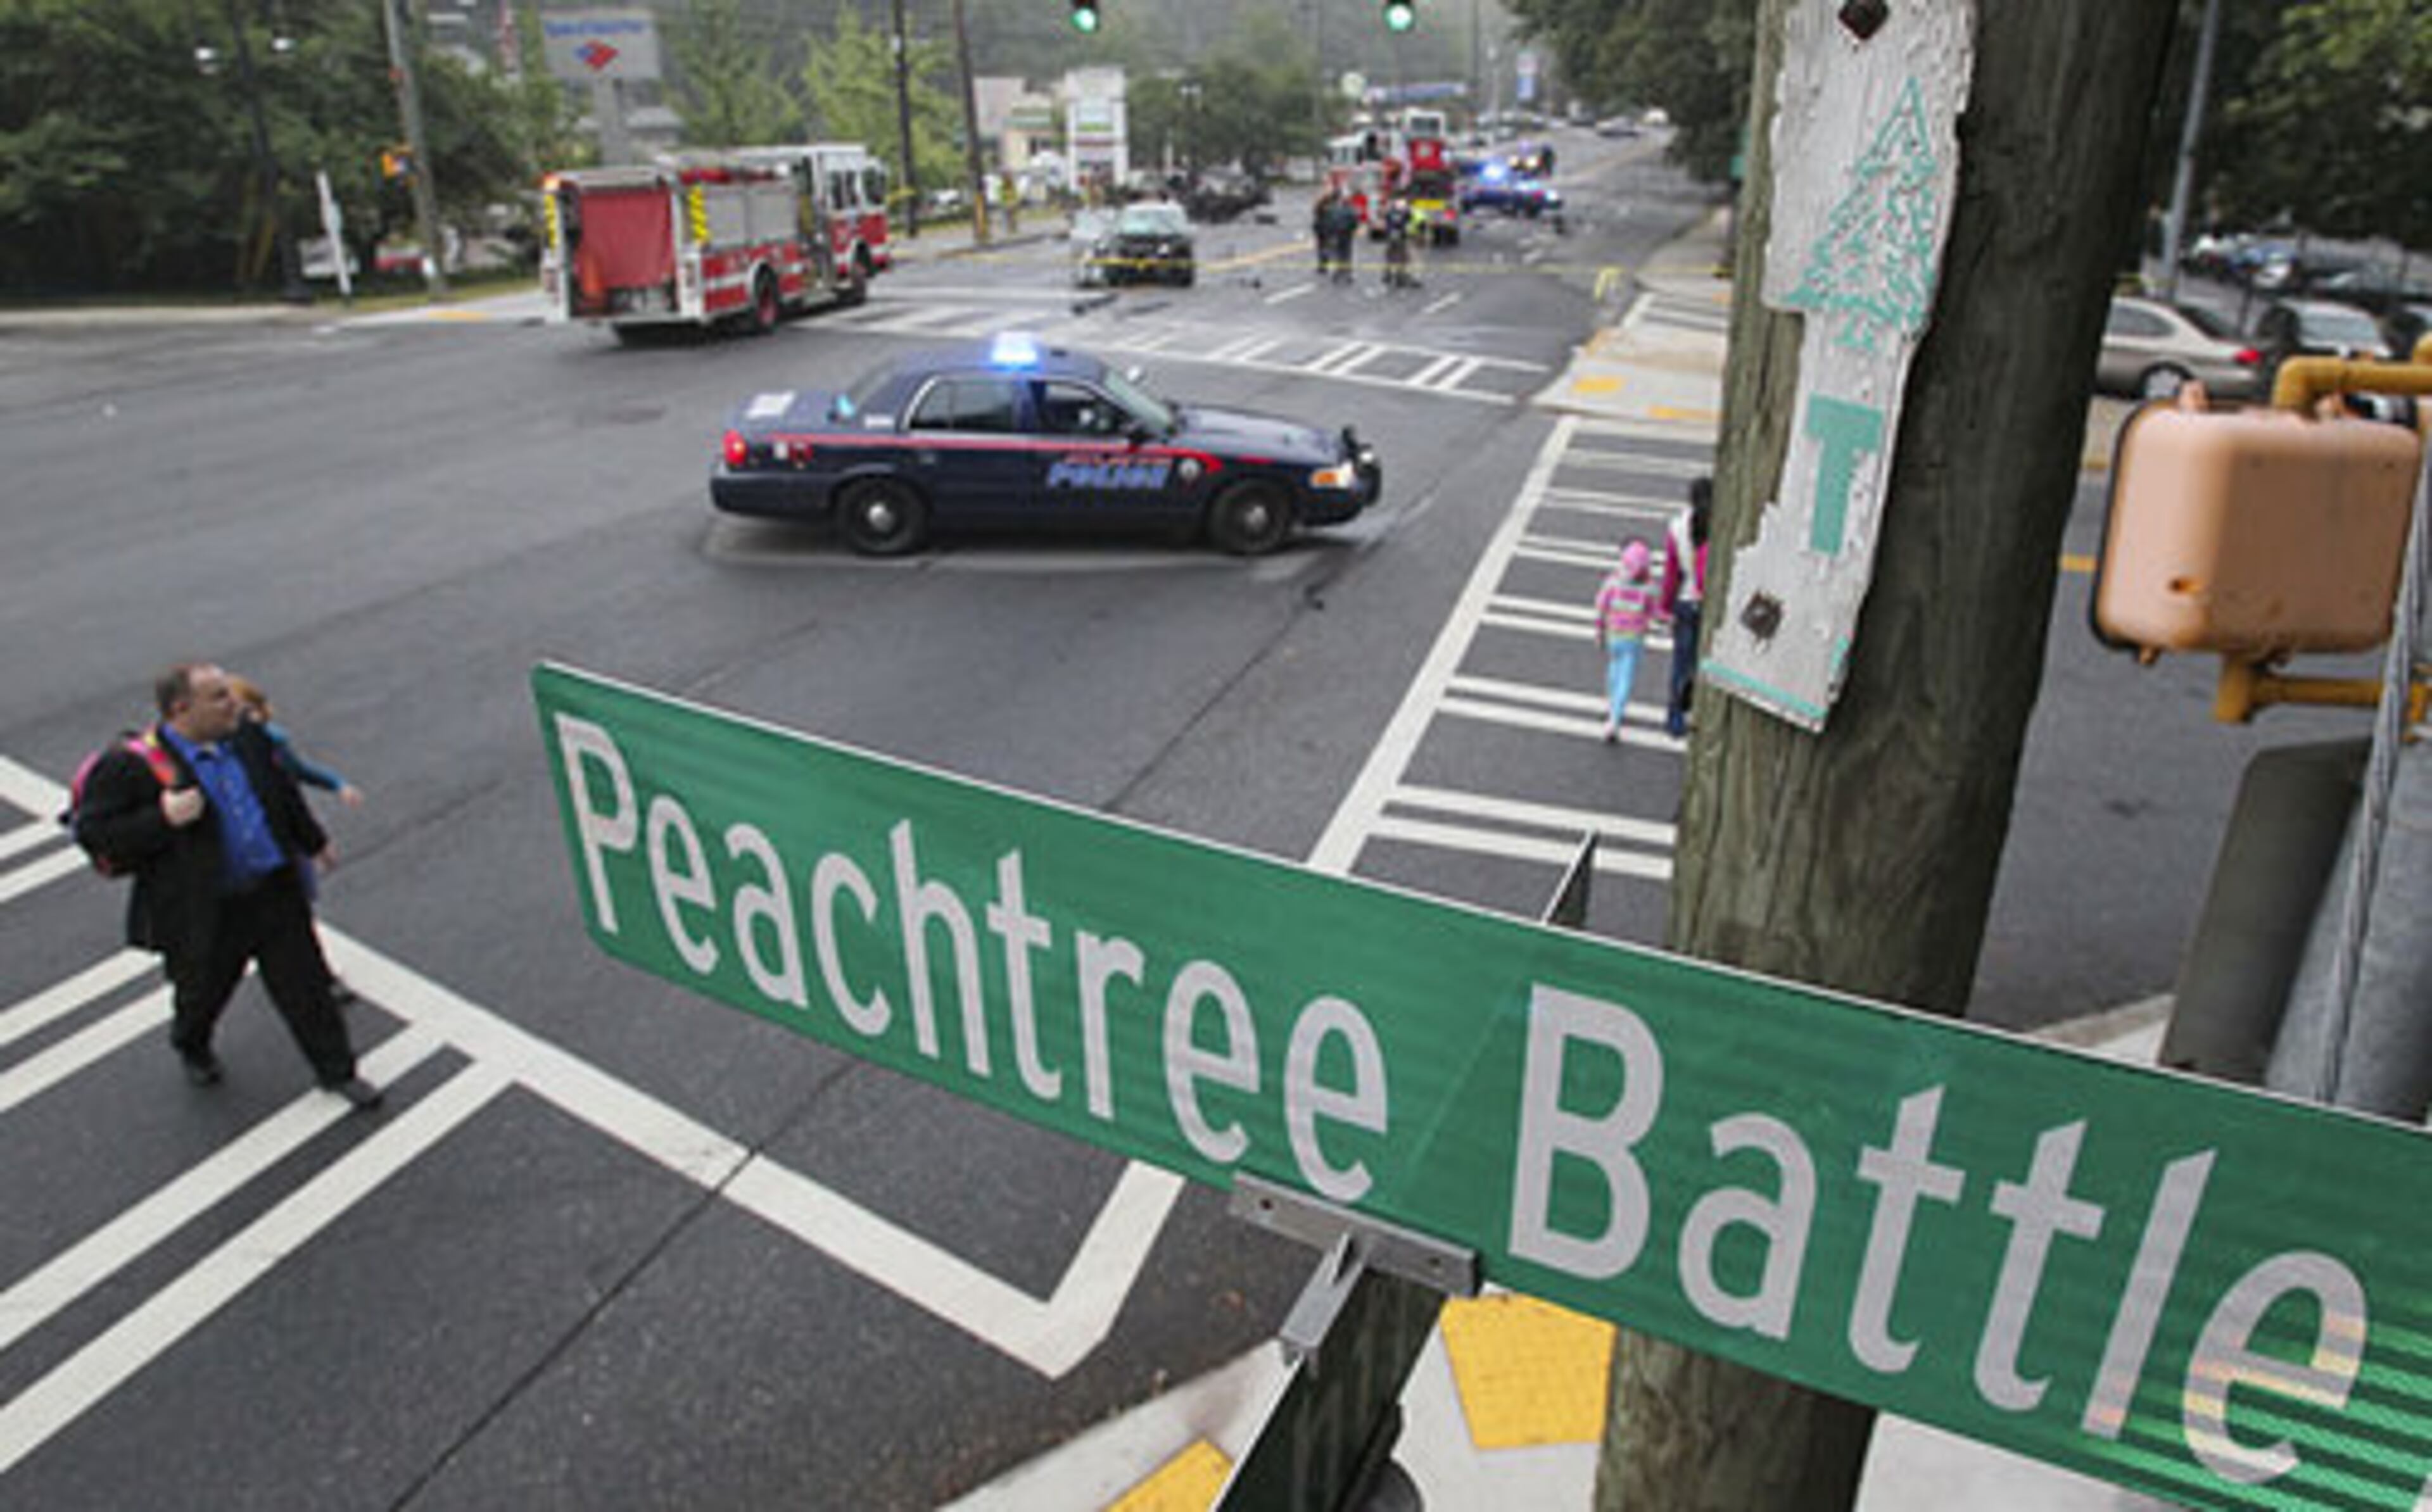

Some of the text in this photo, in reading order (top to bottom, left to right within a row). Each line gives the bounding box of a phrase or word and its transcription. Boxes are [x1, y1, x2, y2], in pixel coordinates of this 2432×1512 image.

[1047, 462, 1170, 489] POLICE
[1804, 392, 1884, 557] T
[554, 711, 2368, 1485] Peachtree Battle
